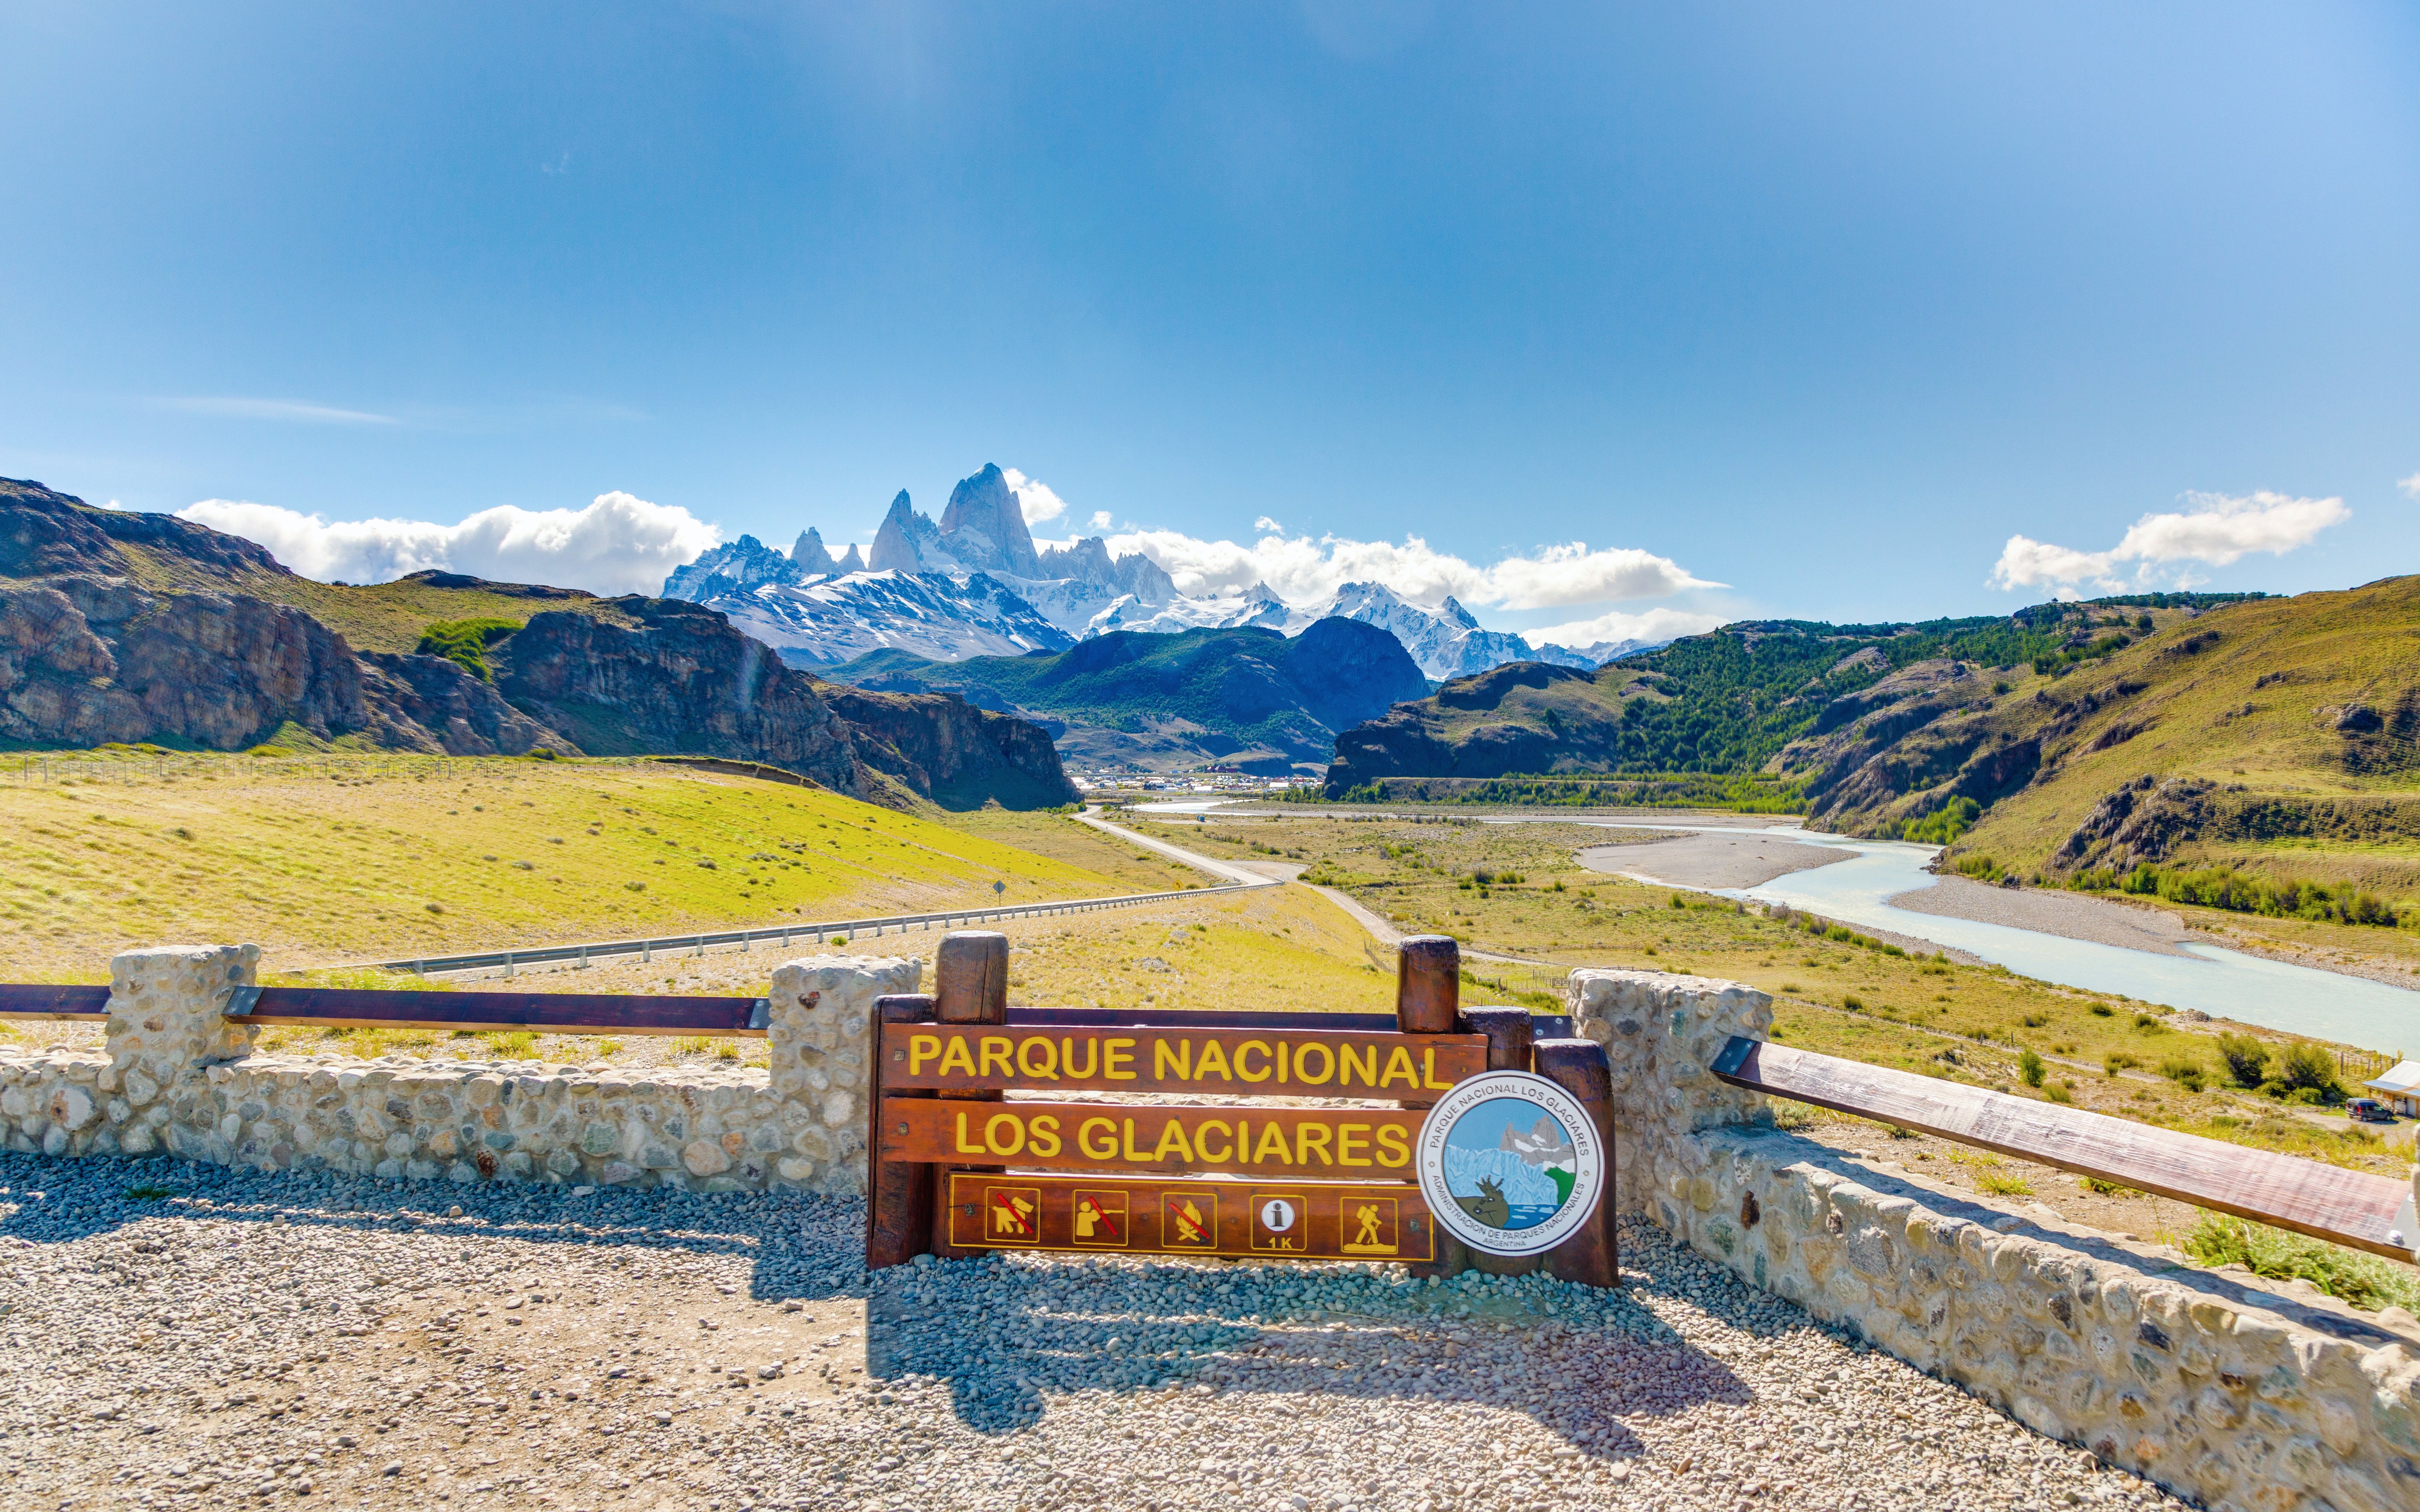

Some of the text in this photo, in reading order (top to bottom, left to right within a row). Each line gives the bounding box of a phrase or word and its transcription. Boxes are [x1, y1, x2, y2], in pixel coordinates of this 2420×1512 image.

[910, 1034, 1455, 1091] PARQUE NACIONAL
[956, 1112, 1411, 1168] LOS GLACIARES
[1430, 1084, 1589, 1156] PARQUE NACIONAL LOS GLACIARES
[1432, 1175, 1585, 1239] ADMINISTRACION DE PARQUES NACIONALES
[1268, 1237, 1292, 1249] 1 K
[1483, 1238, 1526, 1247] ARGENTINA
